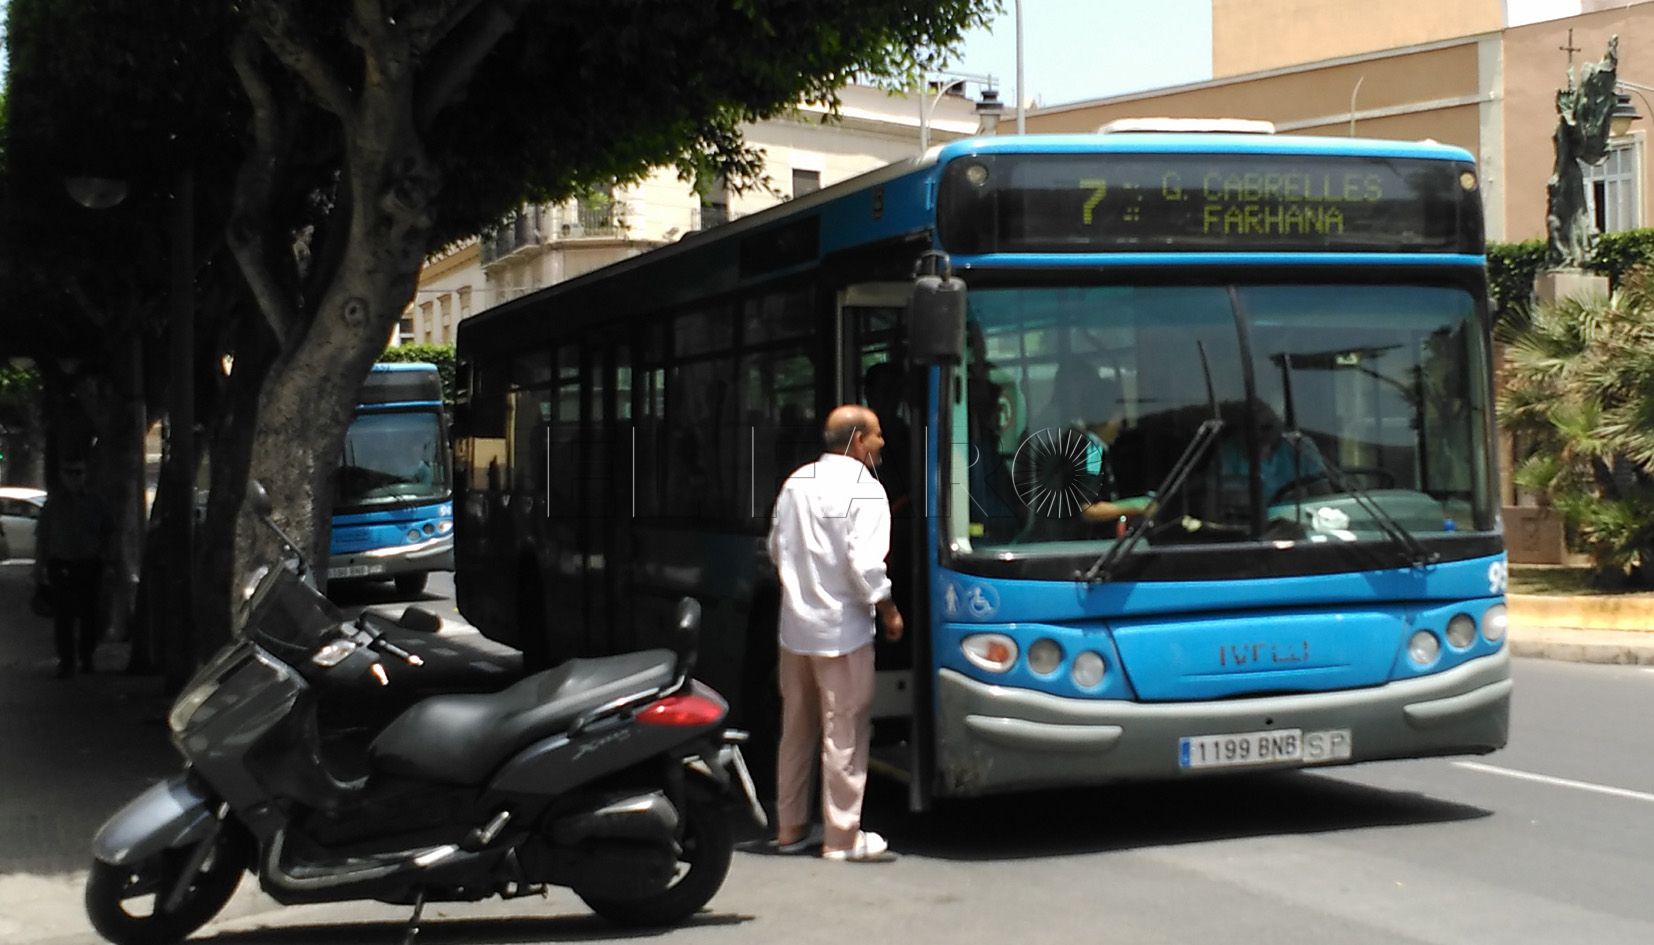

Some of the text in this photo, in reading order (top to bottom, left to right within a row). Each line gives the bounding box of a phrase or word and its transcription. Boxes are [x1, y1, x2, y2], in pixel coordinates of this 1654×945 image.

[1079, 178, 1107, 225] 7
[1202, 172, 1383, 202] CABRELLES
[1202, 204, 1345, 235] FARHANA
[1199, 737, 1251, 763] 1199
[1257, 734, 1298, 759] BNB
